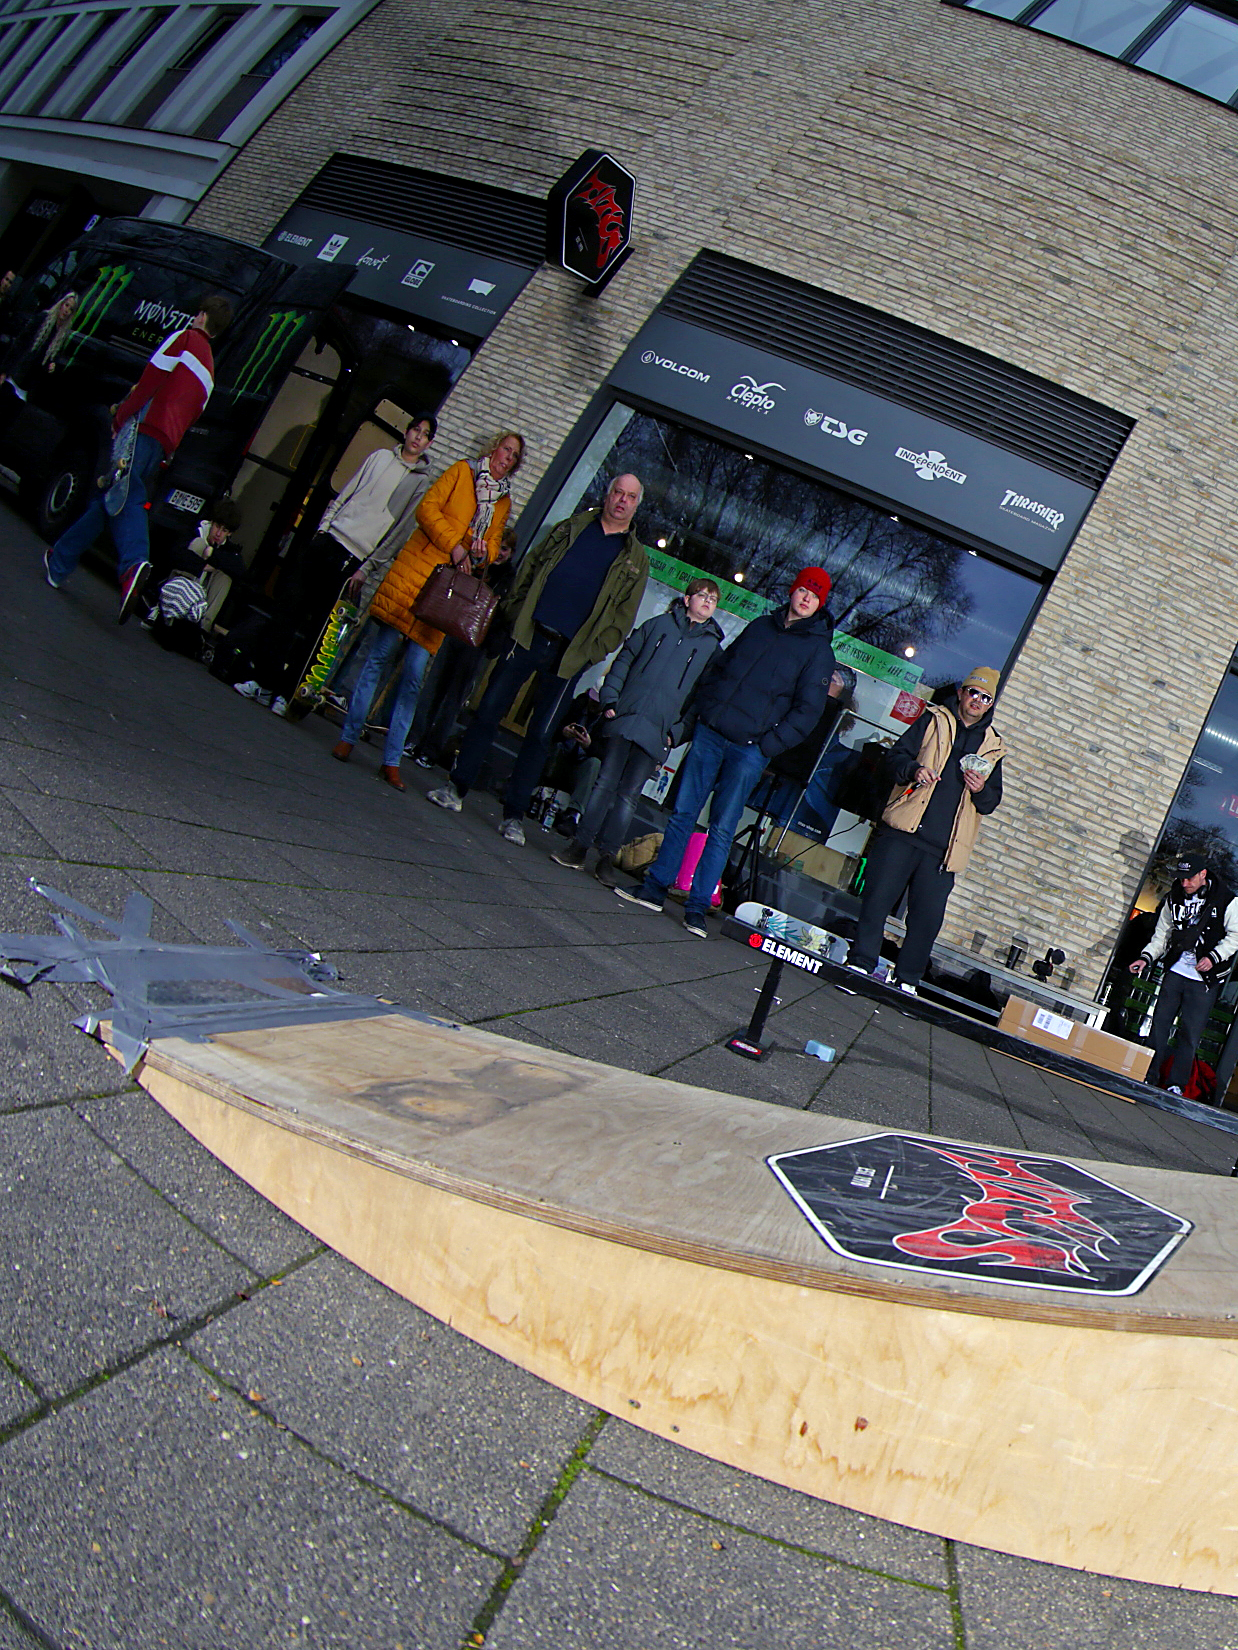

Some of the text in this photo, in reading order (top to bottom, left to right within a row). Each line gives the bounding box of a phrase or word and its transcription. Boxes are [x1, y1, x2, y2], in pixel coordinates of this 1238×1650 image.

[283, 232, 313, 247] ELEMENT
[404, 275, 422, 287] GLOBE
[472, 304, 497, 316] COLLECTION
[132, 327, 164, 345] ENER
[654, 355, 711, 383] VOLCOM
[820, 414, 868, 446] TSG
[899, 449, 963, 482] INDEPENDENT
[999, 505, 1057, 534] SKATEBOARD MAGAZINE
[1000, 489, 1066, 530] THRASHER
[761, 939, 824, 974] ELEMENT
